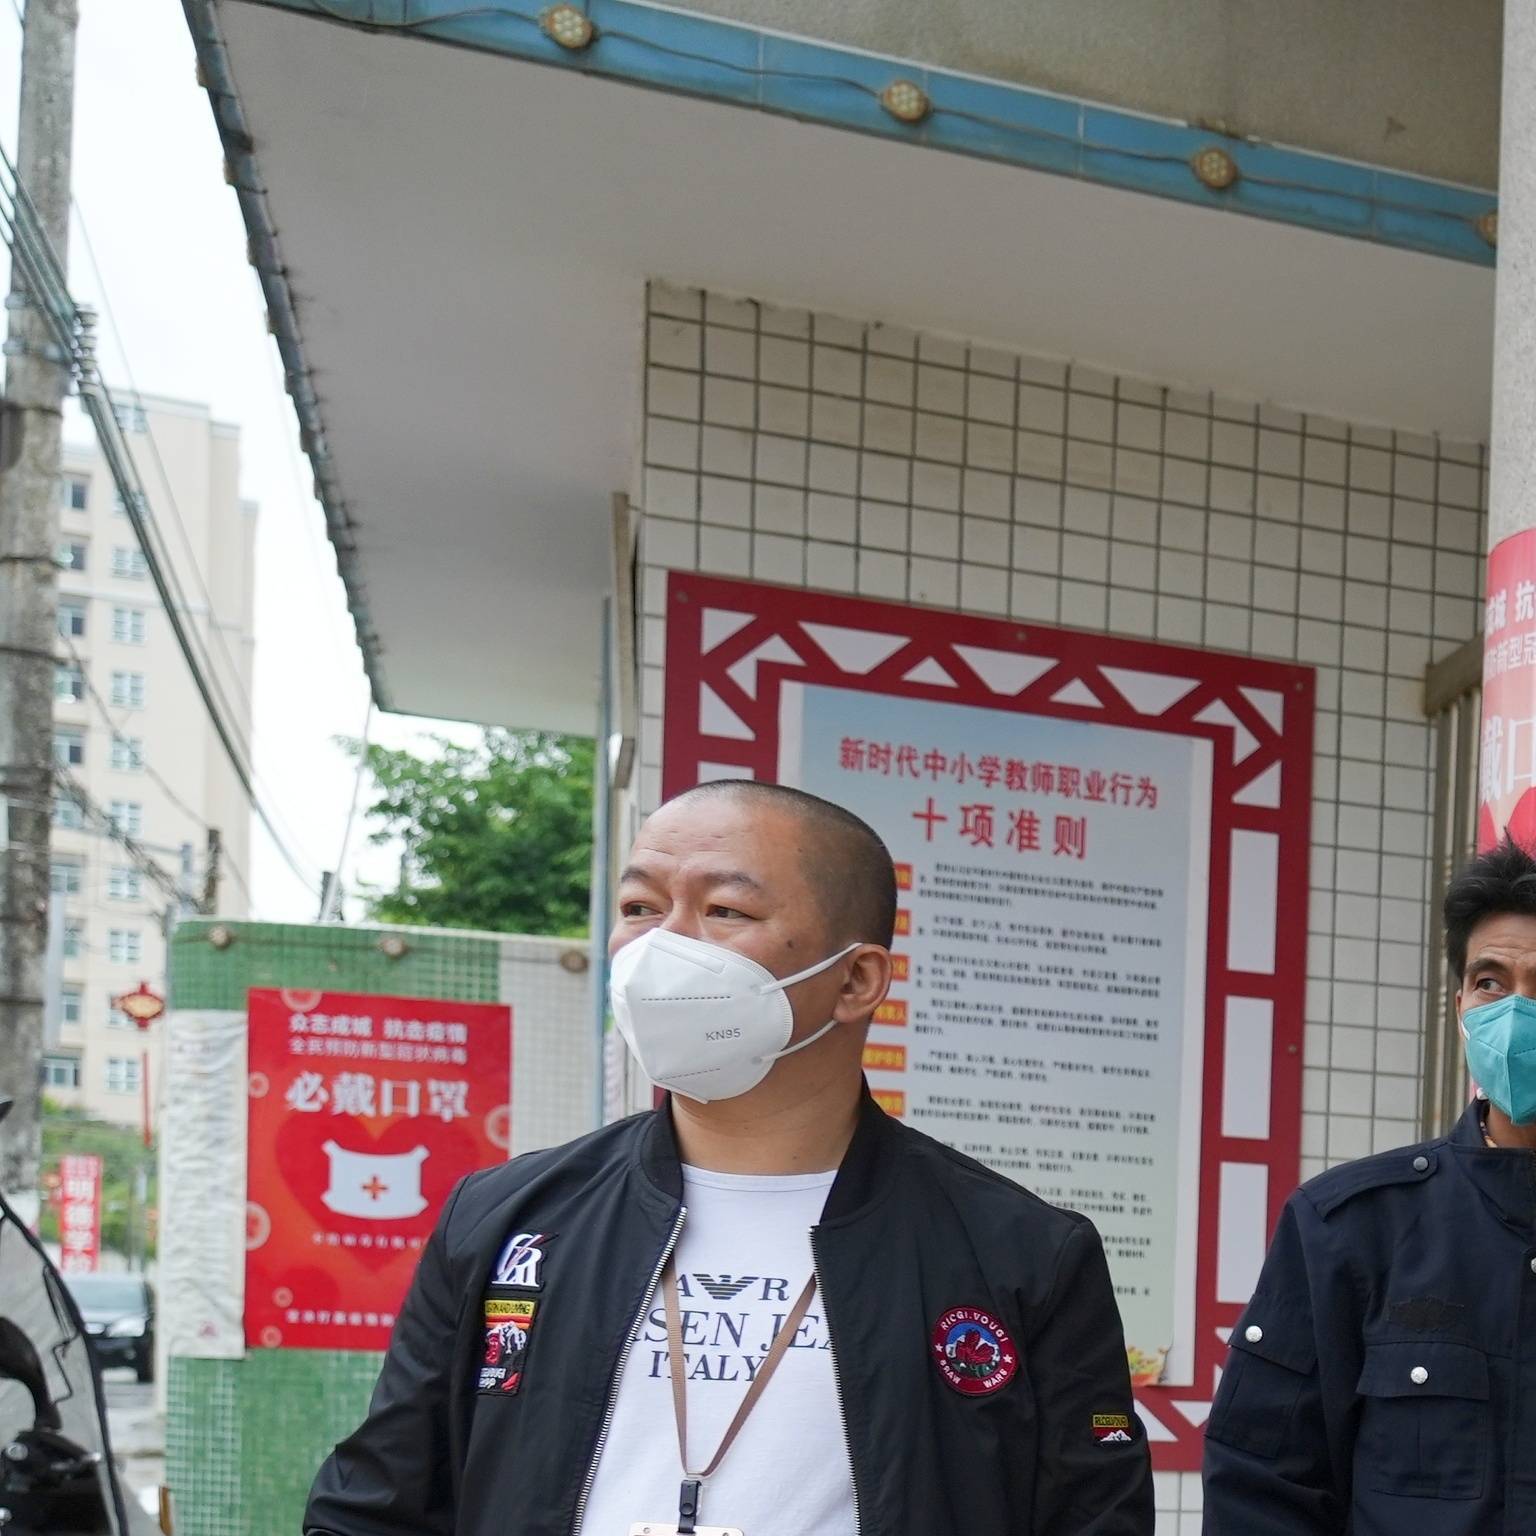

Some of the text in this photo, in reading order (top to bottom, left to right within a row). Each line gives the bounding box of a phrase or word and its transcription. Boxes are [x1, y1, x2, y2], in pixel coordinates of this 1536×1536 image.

[839, 736, 1159, 811] 新时代中小学教师职业行为
[912, 796, 1089, 860] 十项准则
[705, 1027, 741, 1041] KN95
[285, 1070, 470, 1123] 必戴口罩
[760, 1313, 834, 1352] JE
